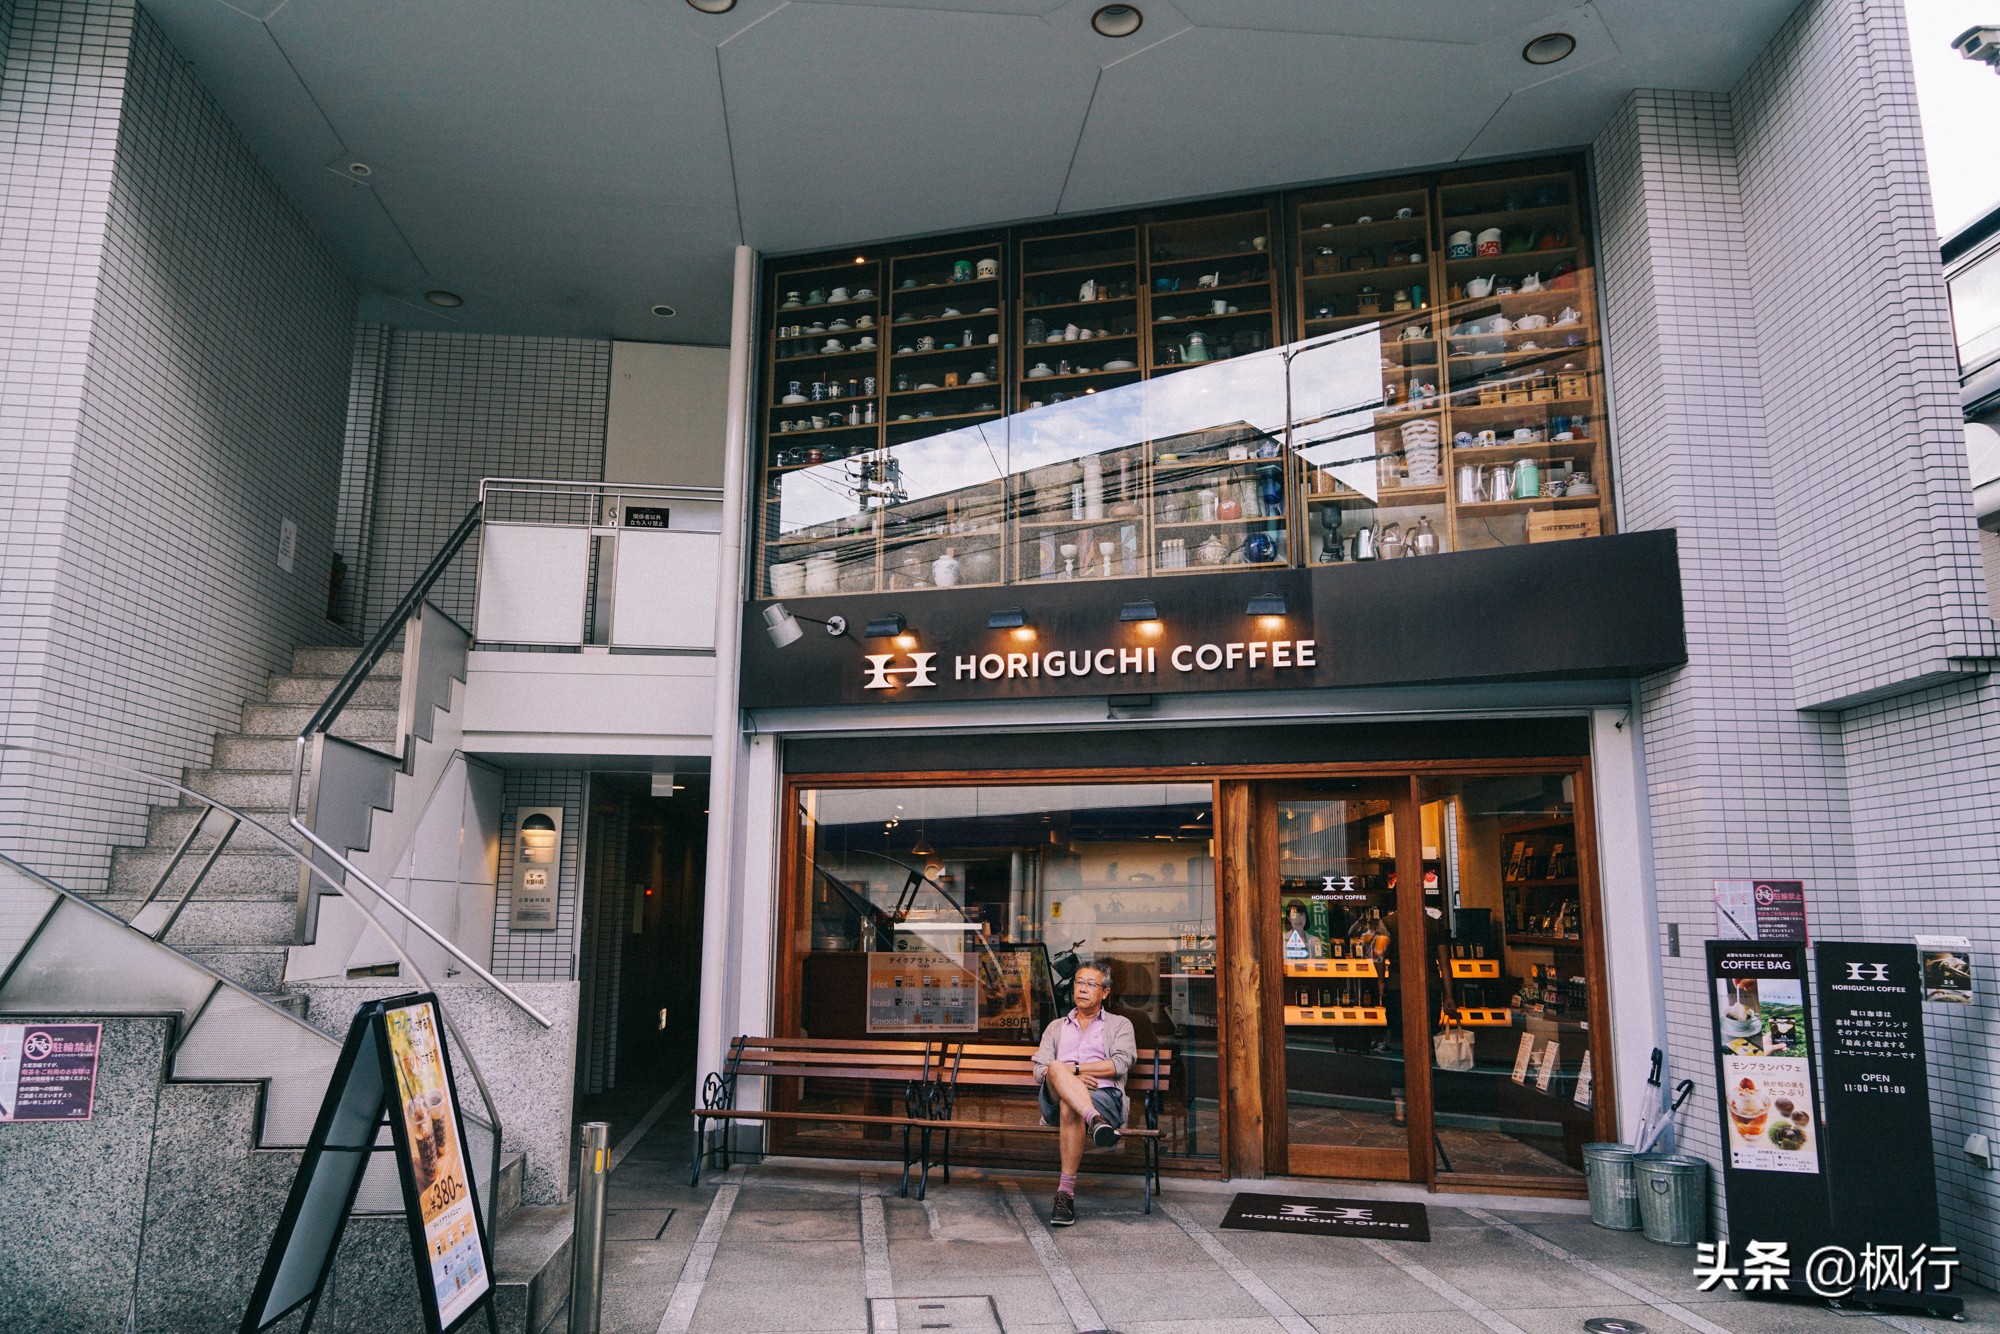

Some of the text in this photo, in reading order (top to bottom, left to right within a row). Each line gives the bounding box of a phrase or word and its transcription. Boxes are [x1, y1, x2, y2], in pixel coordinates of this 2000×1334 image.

[954, 639, 1317, 681] HORIGUCHI COFFEE
[1721, 960, 1791, 970] COFFEE BAG
[1832, 984, 1875, 992] HORIGUCHI
[872, 999, 891, 1007] Iced
[1850, 1010, 1892, 1018] 堀口珈琲は
[872, 1017, 908, 1025] Smoothie
[1000, 1017, 1029, 1027] 380円
[1835, 1019, 1908, 1028] 素材・焙煎・ブレンド
[1837, 1029, 1908, 1039] そのすべてにおいて
[52, 1042, 94, 1053] 駐輪禁止
[1840, 1039, 1905, 1049] 「最高」を追求する
[1833, 1049, 1917, 1059] コーヒーロースターです
[1861, 1073, 1891, 1083] OPEN
[1768, 1088, 1805, 1097] たっぷり
[1241, 1213, 1410, 1229] HORIGUCHI COFFEE
